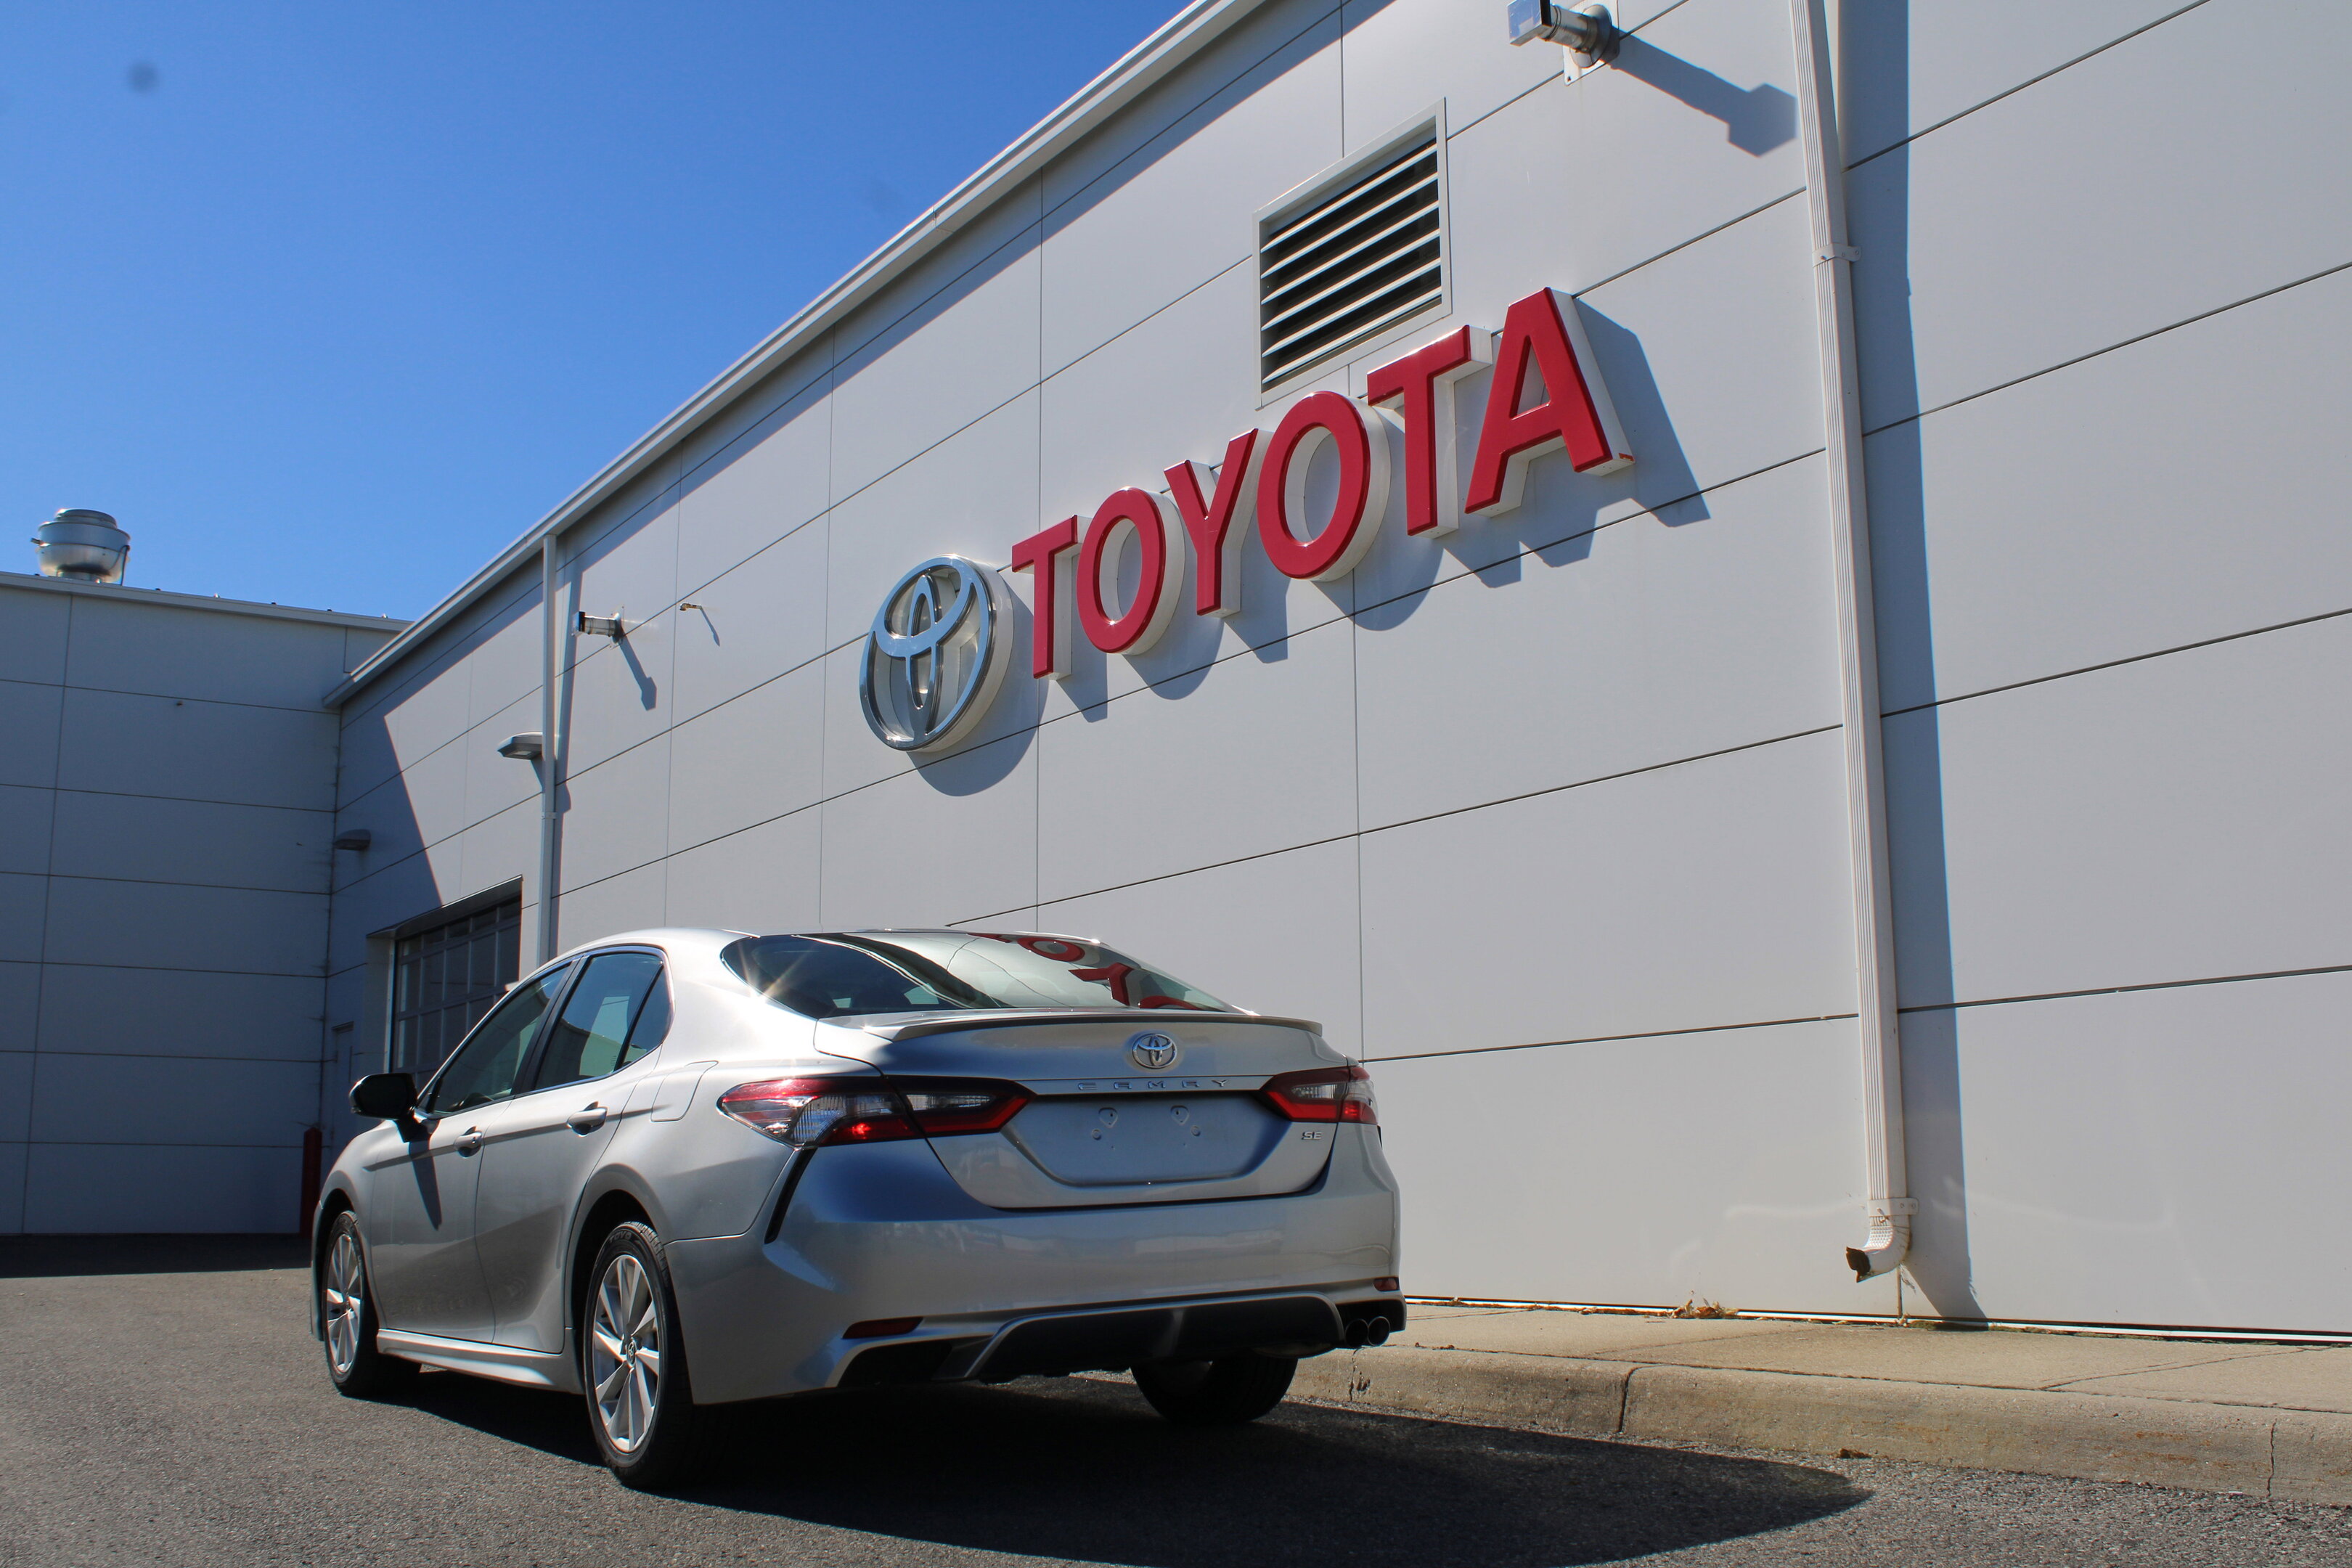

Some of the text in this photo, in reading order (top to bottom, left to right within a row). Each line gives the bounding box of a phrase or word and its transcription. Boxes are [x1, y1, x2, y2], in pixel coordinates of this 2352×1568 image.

[1012, 287, 1616, 679] TOYOTA
[1077, 1079, 1229, 1090] CAMRY
[1301, 1131, 1322, 1140] SE
